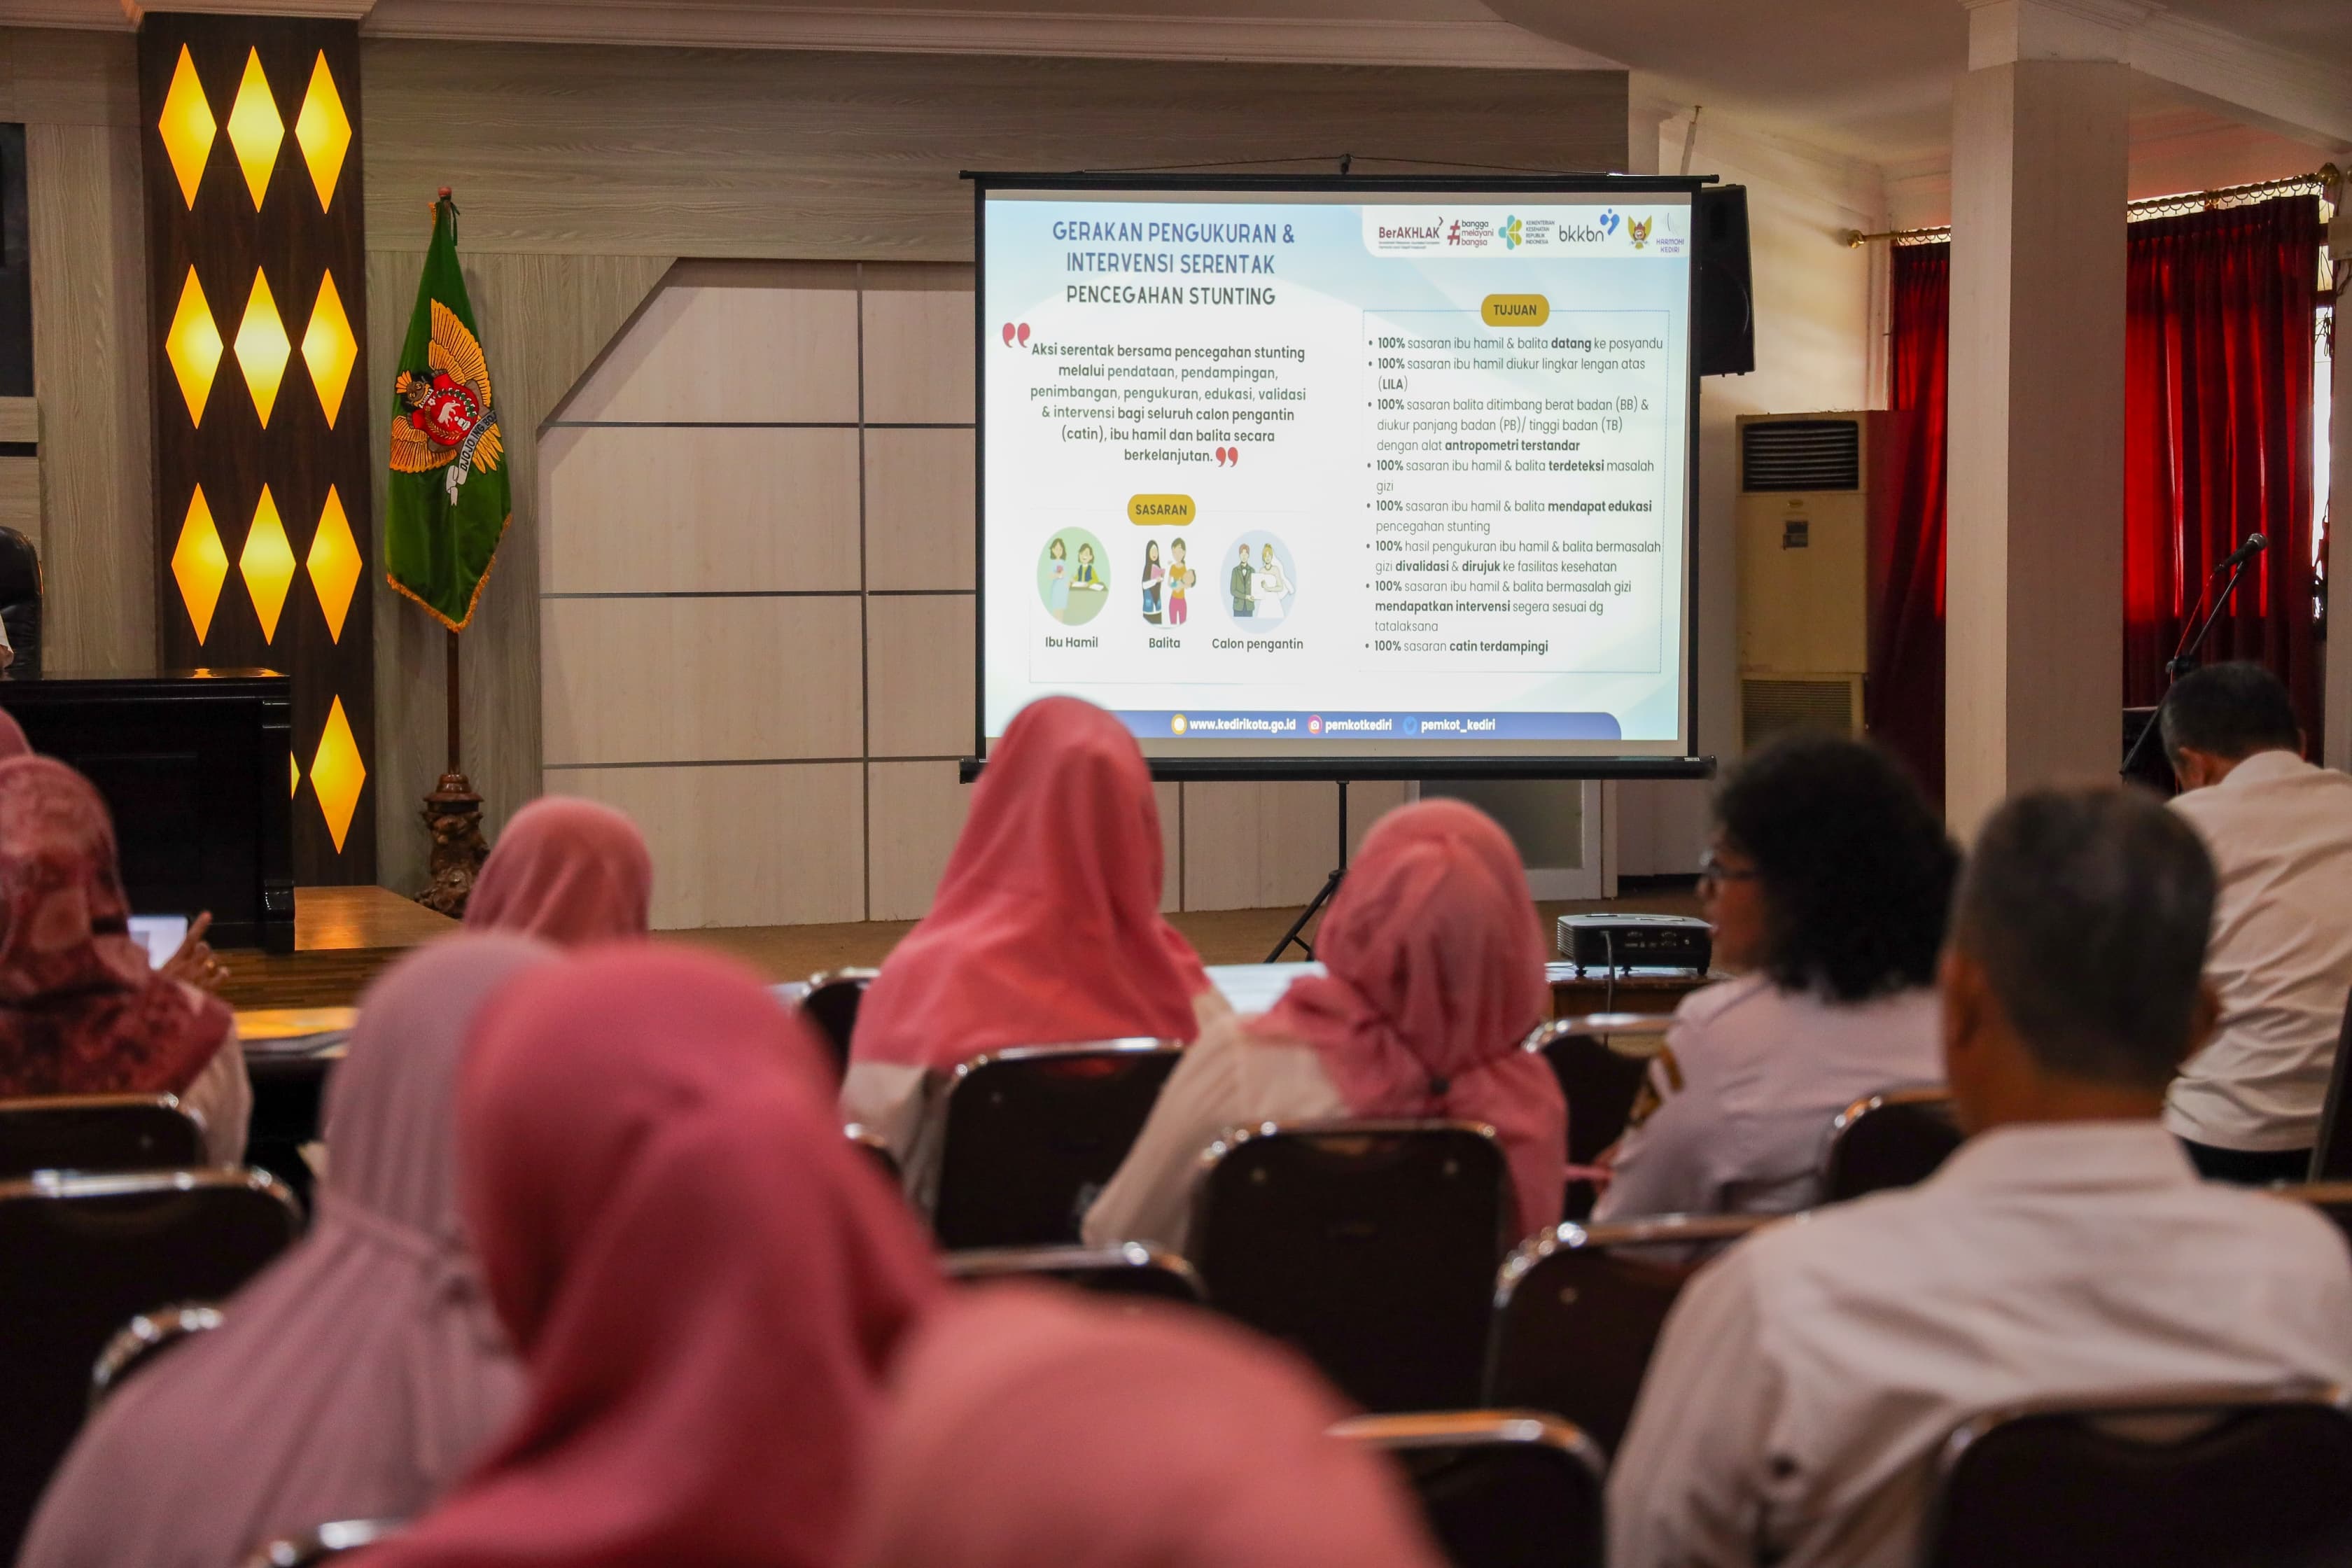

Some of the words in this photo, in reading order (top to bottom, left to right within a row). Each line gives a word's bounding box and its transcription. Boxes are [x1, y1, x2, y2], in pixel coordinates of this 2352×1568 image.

[1053, 221, 1142, 241] GERAKAN
[1149, 223, 1276, 243] PENGUKURAN
[1283, 224, 1295, 243] &
[1379, 227, 1440, 238] BerAKHLAK
[1462, 220, 1489, 230] bangga
[1462, 229, 1494, 238] melayani
[1560, 225, 1604, 241] bkkbn
[1462, 238, 1488, 248] bangsa
[1068, 253, 1173, 272] INTERVENSI
[1181, 254, 1275, 274] SERENTAK
[1068, 286, 1183, 304] PENCEGAHAN
[1190, 287, 1275, 304] STUNTING
[1494, 304, 1537, 315] TUJUAN
[1378, 337, 1406, 348] 100%
[1408, 340, 1451, 349] sasaran
[1455, 337, 1471, 349] ibu
[1474, 337, 1504, 349] hamil
[1507, 337, 1515, 349] &
[1518, 337, 1548, 349] balita
[1551, 337, 1592, 352] datang
[1595, 337, 1606, 349] ke
[1609, 337, 1663, 352] posyandu
[1032, 343, 1058, 355] Aksi
[1060, 344, 1114, 356] serentak
[1118, 344, 1172, 356] bersama
[1175, 346, 1252, 361] pencegahan
[1255, 347, 1305, 363] stunting
[1059, 364, 1105, 376] melalui
[1108, 365, 1178, 381] pendataan,
[1182, 366, 1278, 382] pendampingan,
[1378, 358, 1406, 368] 100%
[1408, 360, 1451, 369] sasaran
[1454, 358, 1471, 369] ibu
[1474, 358, 1504, 370] hamil
[1506, 358, 1540, 369] diukur
[1543, 358, 1578, 373] lingkar
[1581, 358, 1618, 373] lengan
[1621, 358, 1646, 369] atas
[1379, 376, 1408, 391] (LILA)
[1031, 386, 1121, 402] penimbangan,
[1124, 387, 1202, 402] pengukuran,
[1205, 387, 1255, 401] edukasi,
[1259, 388, 1306, 400] validasi
[1378, 399, 1405, 410] 100%
[1407, 401, 1450, 410] sasaran
[1454, 399, 1484, 410] balita
[1487, 399, 1543, 414] ditimbang
[1546, 399, 1574, 410] berat
[1577, 399, 1613, 410] badan
[1616, 396, 1638, 412] (BB)
[1642, 399, 1649, 410] &
[1042, 406, 1050, 417] &
[1054, 406, 1115, 418] intervensi
[1119, 407, 1144, 423] bagi
[1148, 407, 1194, 419] seluruh
[1196, 409, 1229, 420] calon
[1233, 410, 1294, 424] pengantin
[1378, 419, 1410, 430] diukur
[1413, 419, 1458, 434] panjang
[1462, 419, 1496, 430] badan
[1500, 416, 1527, 433] (PB)/
[1530, 419, 1560, 434] tinggi
[1563, 419, 1598, 430] badan
[1602, 416, 1623, 433] (TB)
[1062, 425, 1107, 442] (catin),
[1111, 428, 1129, 440] ibu
[1133, 428, 1166, 440] hamil
[1170, 429, 1194, 441] dan
[1196, 429, 1231, 441] balita
[1234, 433, 1275, 441] secara
[460, 438, 475, 472] DJOJO
[470, 423, 485, 440] ING
[1377, 440, 1419, 454] dengan
[1422, 440, 1443, 451] alat
[1446, 439, 1519, 454] antropometri
[1522, 440, 1581, 450] terstandar
[1125, 449, 1213, 465] berkelanjutan.
[1377, 460, 1404, 470] 100%
[1452, 459, 1469, 470] ibu
[1472, 459, 1502, 470] hamil
[1504, 460, 1513, 470] &
[1516, 460, 1546, 470] balita
[1549, 459, 1604, 471] terdeteksi
[1607, 460, 1654, 471] masalah
[1377, 482, 1394, 495] gizi
[1136, 504, 1187, 515] SASARAN
[1377, 500, 1404, 511] 100%
[1452, 500, 1468, 511] ibu
[1471, 500, 1502, 511] hamil
[1504, 500, 1511, 512] &
[1515, 500, 1545, 511] balita
[1548, 500, 1606, 515] mendapat
[1609, 500, 1652, 512] edukasi
[1376, 521, 1444, 535] pencegahan
[1448, 521, 1490, 536] stunting
[1376, 540, 1403, 551] 100%
[1406, 540, 1429, 551] hasil
[1433, 540, 1497, 555] pengukuran
[1500, 540, 1516, 552] ibu
[1520, 540, 1549, 552] hamil
[1552, 541, 1560, 552] &
[1563, 541, 1593, 552] balita
[1597, 541, 1661, 552] bermasalah
[1376, 561, 1393, 575] gizi
[1396, 561, 1449, 571] divalidasi
[1452, 561, 1460, 571] &
[1462, 561, 1501, 575] dirujuk
[1504, 561, 1516, 571] ke
[1518, 560, 1558, 572] fasilitas
[1562, 561, 1617, 572] kesehatan
[1376, 580, 1402, 591] 100%
[1405, 583, 1448, 592] sasaran
[1451, 581, 1466, 592] ibu
[1470, 580, 1499, 592] hamil
[1503, 581, 1510, 592] &
[1513, 580, 1544, 592] balita
[1547, 581, 1611, 592] bermasalah
[1614, 581, 1632, 596] gizi
[1376, 601, 1453, 615] mendapatkan
[1456, 600, 1511, 611] intervensi
[1513, 603, 1550, 615] segera
[1553, 603, 1587, 612] sesuai
[1590, 601, 1604, 615] dg
[1376, 621, 1438, 631] tatalaksana
[1046, 636, 1063, 647] Ibu
[1066, 636, 1098, 648] Hamil
[1149, 637, 1181, 648] Balita
[1212, 638, 1244, 648] Calon
[1247, 638, 1303, 652] pengantin
[1375, 640, 1401, 650] 100%
[1450, 640, 1478, 651] catin
[1480, 640, 1548, 655] terdampingi
[1190, 718, 1296, 733] www.kedirikota.go.id
[1326, 719, 1392, 734] pemkotkediri
[1422, 719, 1496, 733] pemkot_kediri
